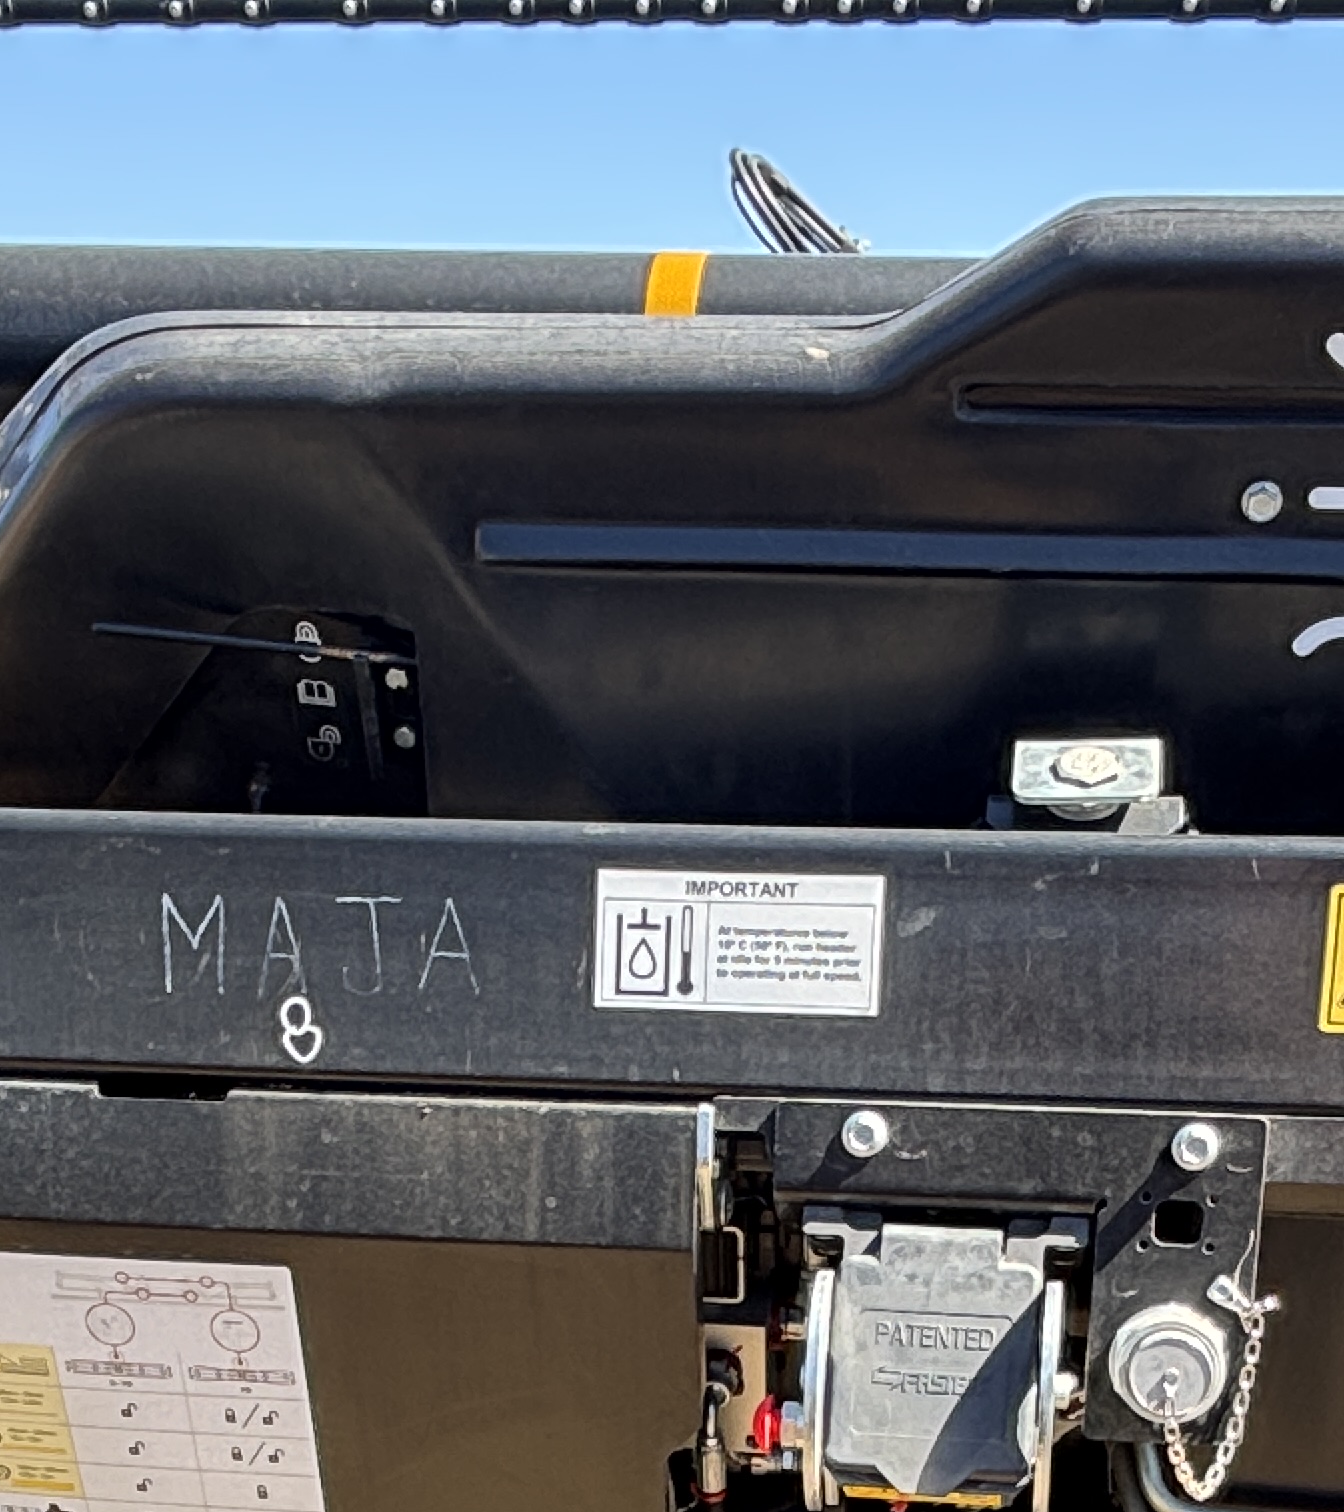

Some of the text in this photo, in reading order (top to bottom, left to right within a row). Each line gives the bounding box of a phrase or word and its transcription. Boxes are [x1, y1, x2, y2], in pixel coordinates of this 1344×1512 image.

[684, 880, 798, 899] IMPORTANT
[874, 1320, 997, 1353] PATENTED
[901, 1371, 976, 1396] FASTE
